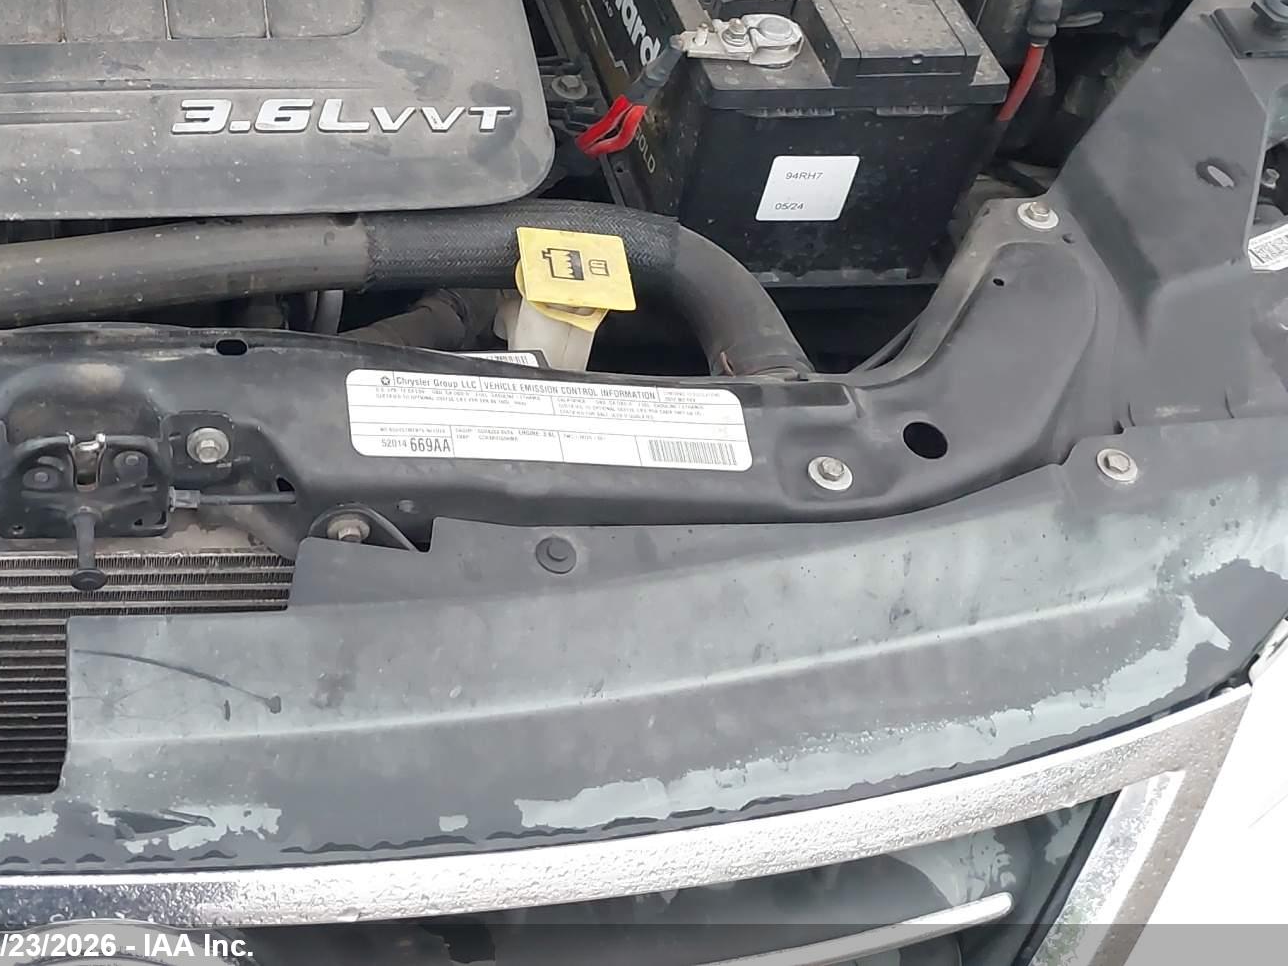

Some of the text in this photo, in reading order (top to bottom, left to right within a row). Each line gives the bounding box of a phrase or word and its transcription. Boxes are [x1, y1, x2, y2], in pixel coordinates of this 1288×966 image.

[785, 171, 823, 181] 94RH7
[774, 202, 804, 211] 05/24
[396, 376, 477, 389] Chrysler Group LLC
[483, 381, 518, 392] VEHICLE
[520, 383, 559, 394] EMISSION
[561, 386, 598, 397] CONTROL
[600, 388, 656, 400] INFORMATION
[410, 437, 451, 452] 669AA
